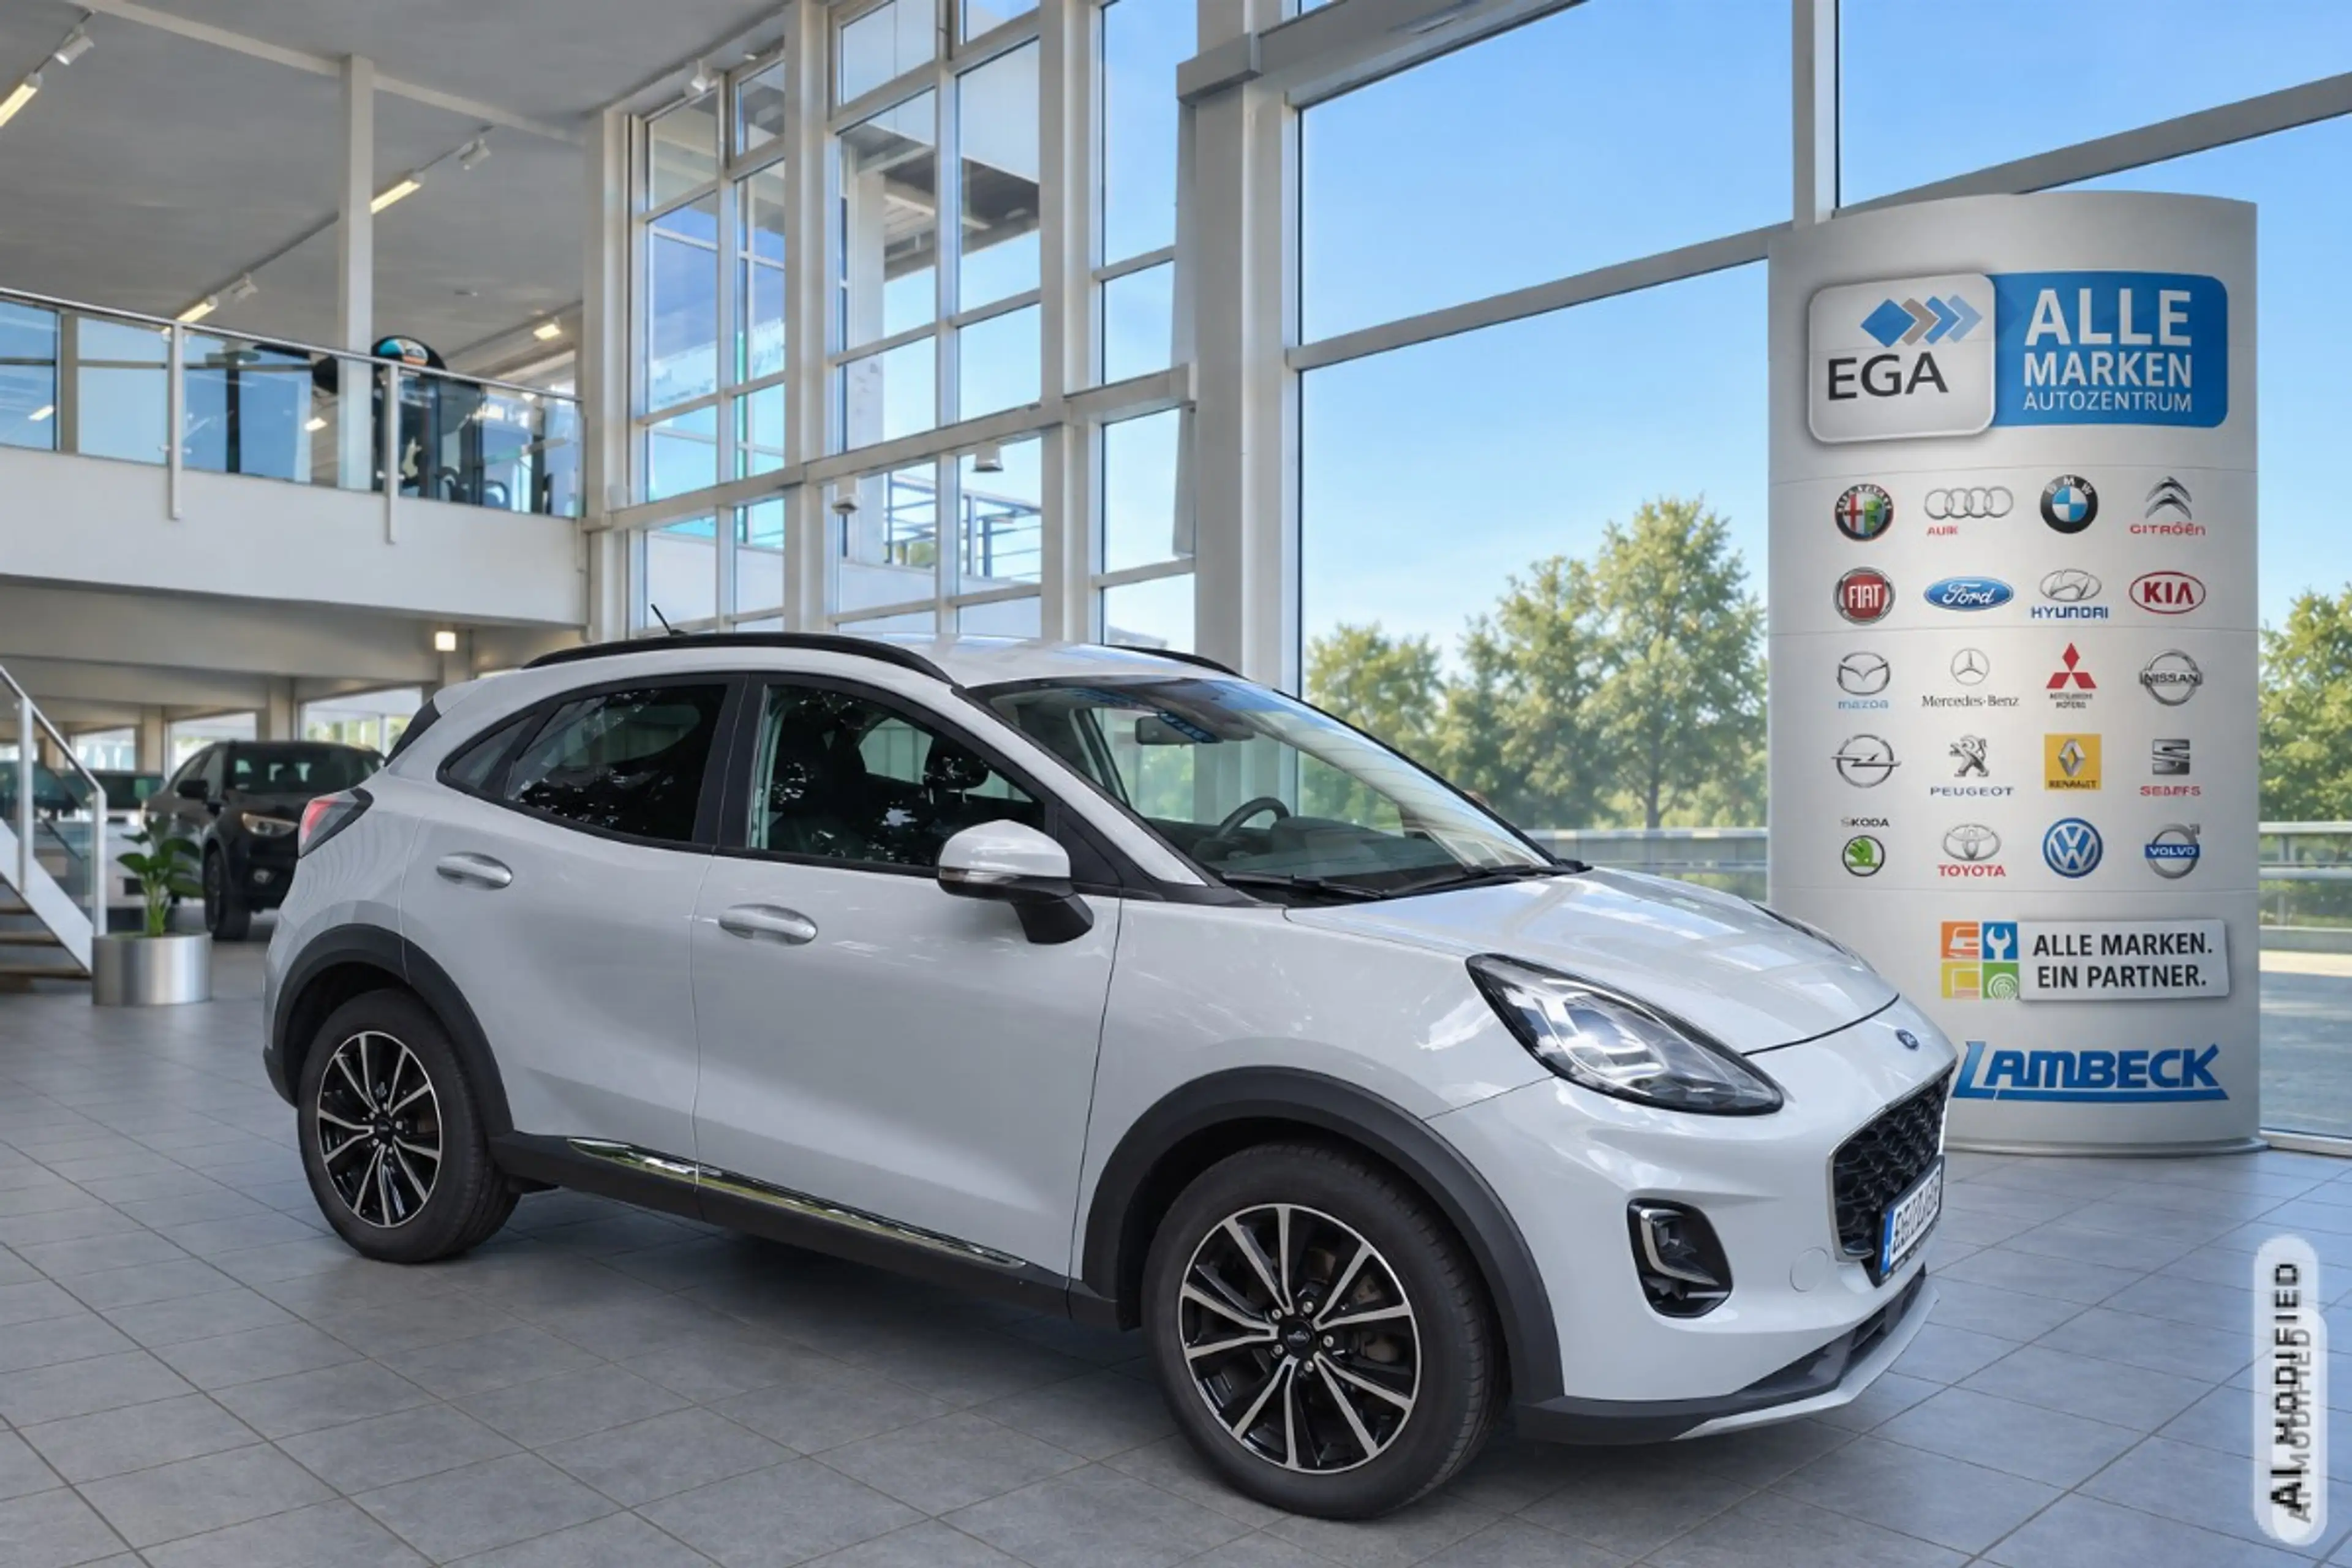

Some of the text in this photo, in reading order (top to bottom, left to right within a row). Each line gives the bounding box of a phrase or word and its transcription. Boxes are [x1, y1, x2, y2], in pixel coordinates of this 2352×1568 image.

[2025, 288, 2192, 347] ALLE
[1827, 352, 1949, 401] EGA
[2024, 352, 2192, 388] MARKEN
[2023, 391, 2192, 413] AUTOZENTRUM
[1847, 584, 1883, 609] FIAT
[1942, 582, 1996, 605] Ford
[2144, 581, 2195, 605] KIA
[2031, 606, 2109, 619] HYUNDAI
[2144, 673, 2198, 684] NISSAN
[1930, 785, 2015, 797] PEUGEOT
[1938, 864, 2007, 877] TOYOTA
[2032, 932, 2213, 957] ALLE MARKEN.
[2037, 965, 2207, 988] EIN PARTNER.
[1952, 1041, 2225, 1101] LAMBECK
